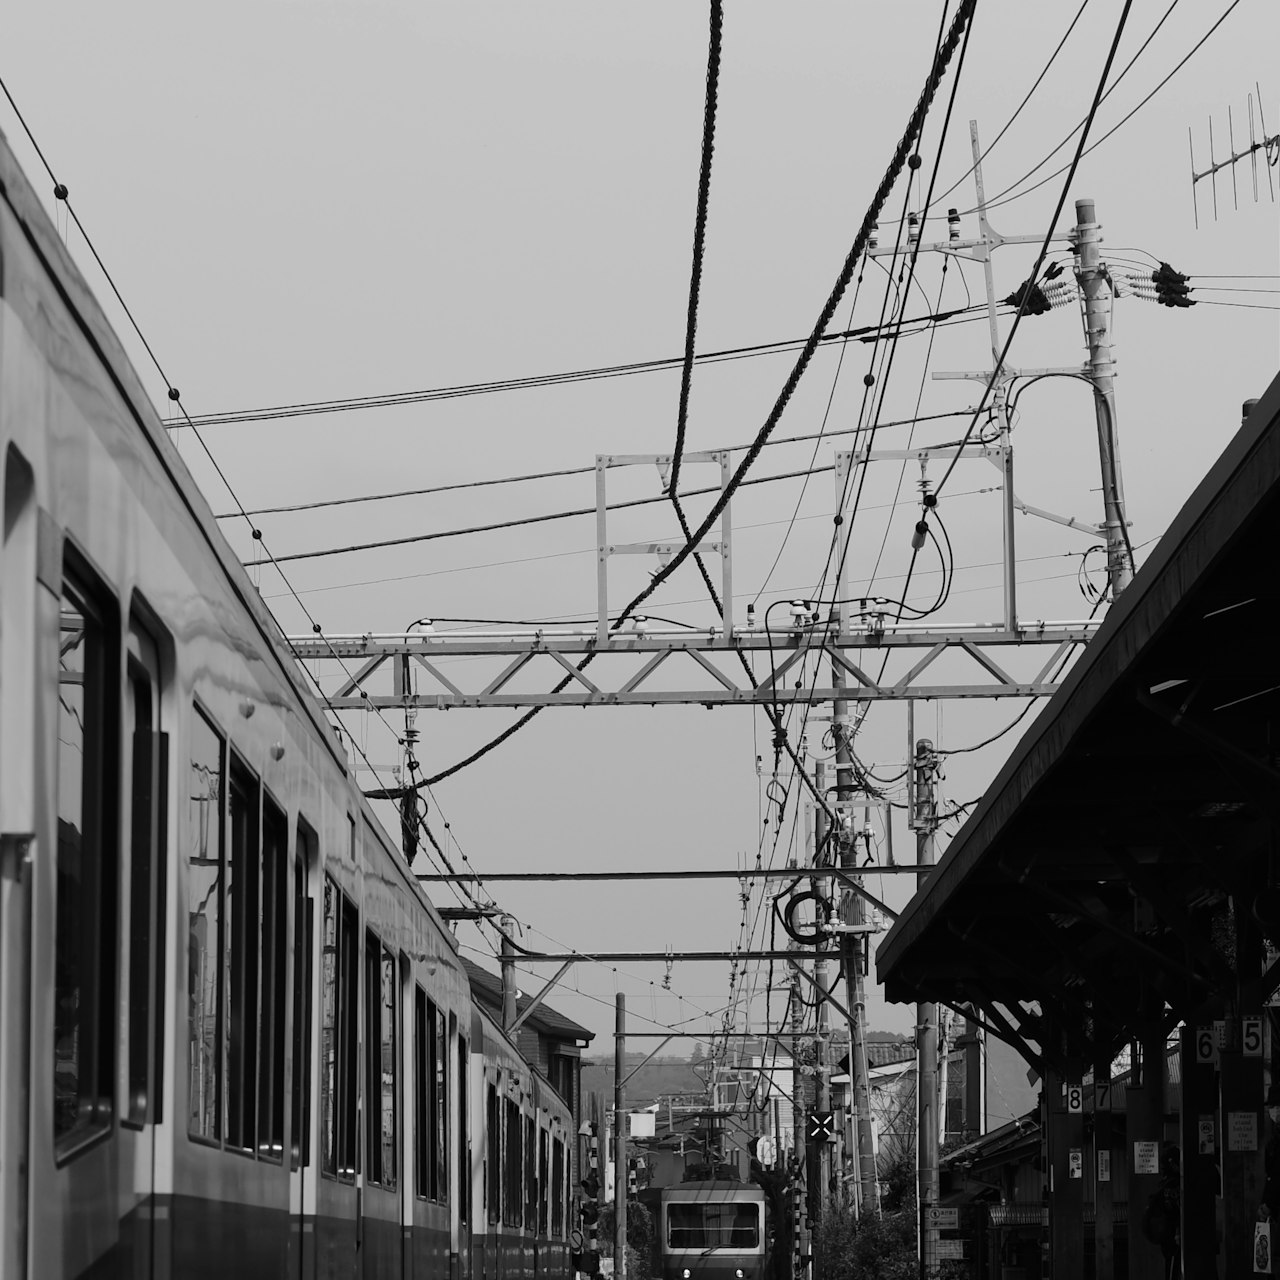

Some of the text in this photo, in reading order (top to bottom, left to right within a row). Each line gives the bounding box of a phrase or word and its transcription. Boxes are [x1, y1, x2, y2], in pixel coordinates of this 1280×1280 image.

[1199, 1032, 1213, 1058] 6
[1245, 1023, 1260, 1051] 5
[1070, 1089, 1081, 1109] 8
[1097, 1085, 1109, 1107] 7
